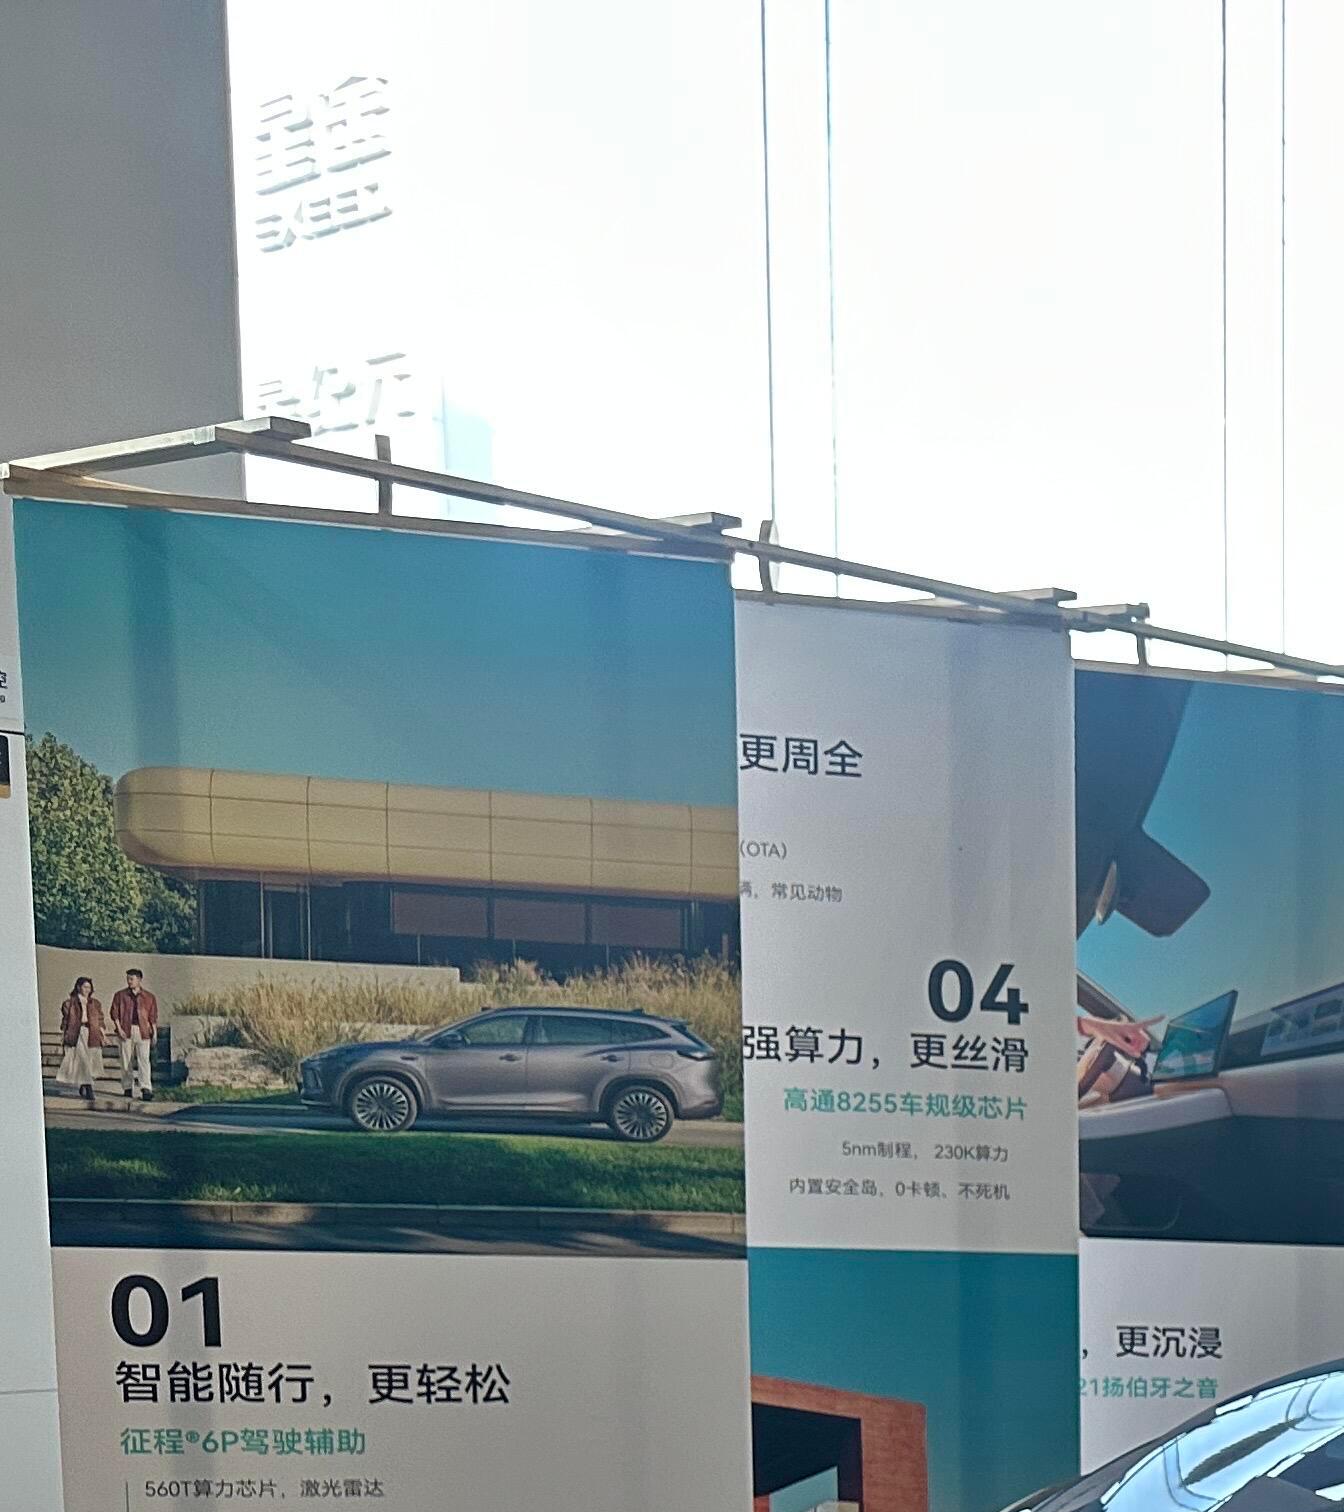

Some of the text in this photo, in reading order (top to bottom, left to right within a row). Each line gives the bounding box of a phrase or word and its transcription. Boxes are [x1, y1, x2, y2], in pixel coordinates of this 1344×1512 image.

[740, 733, 863, 777] 更周全
[740, 840, 787, 859] (OTA)
[927, 958, 1030, 1026] 04
[742, 1026, 1030, 1074] 强算力，更丝滑
[784, 1087, 1028, 1121] 高通8255车规级芯片
[111, 1275, 222, 1348] 01
[115, 1361, 512, 1408] 智能随行，更轻松
